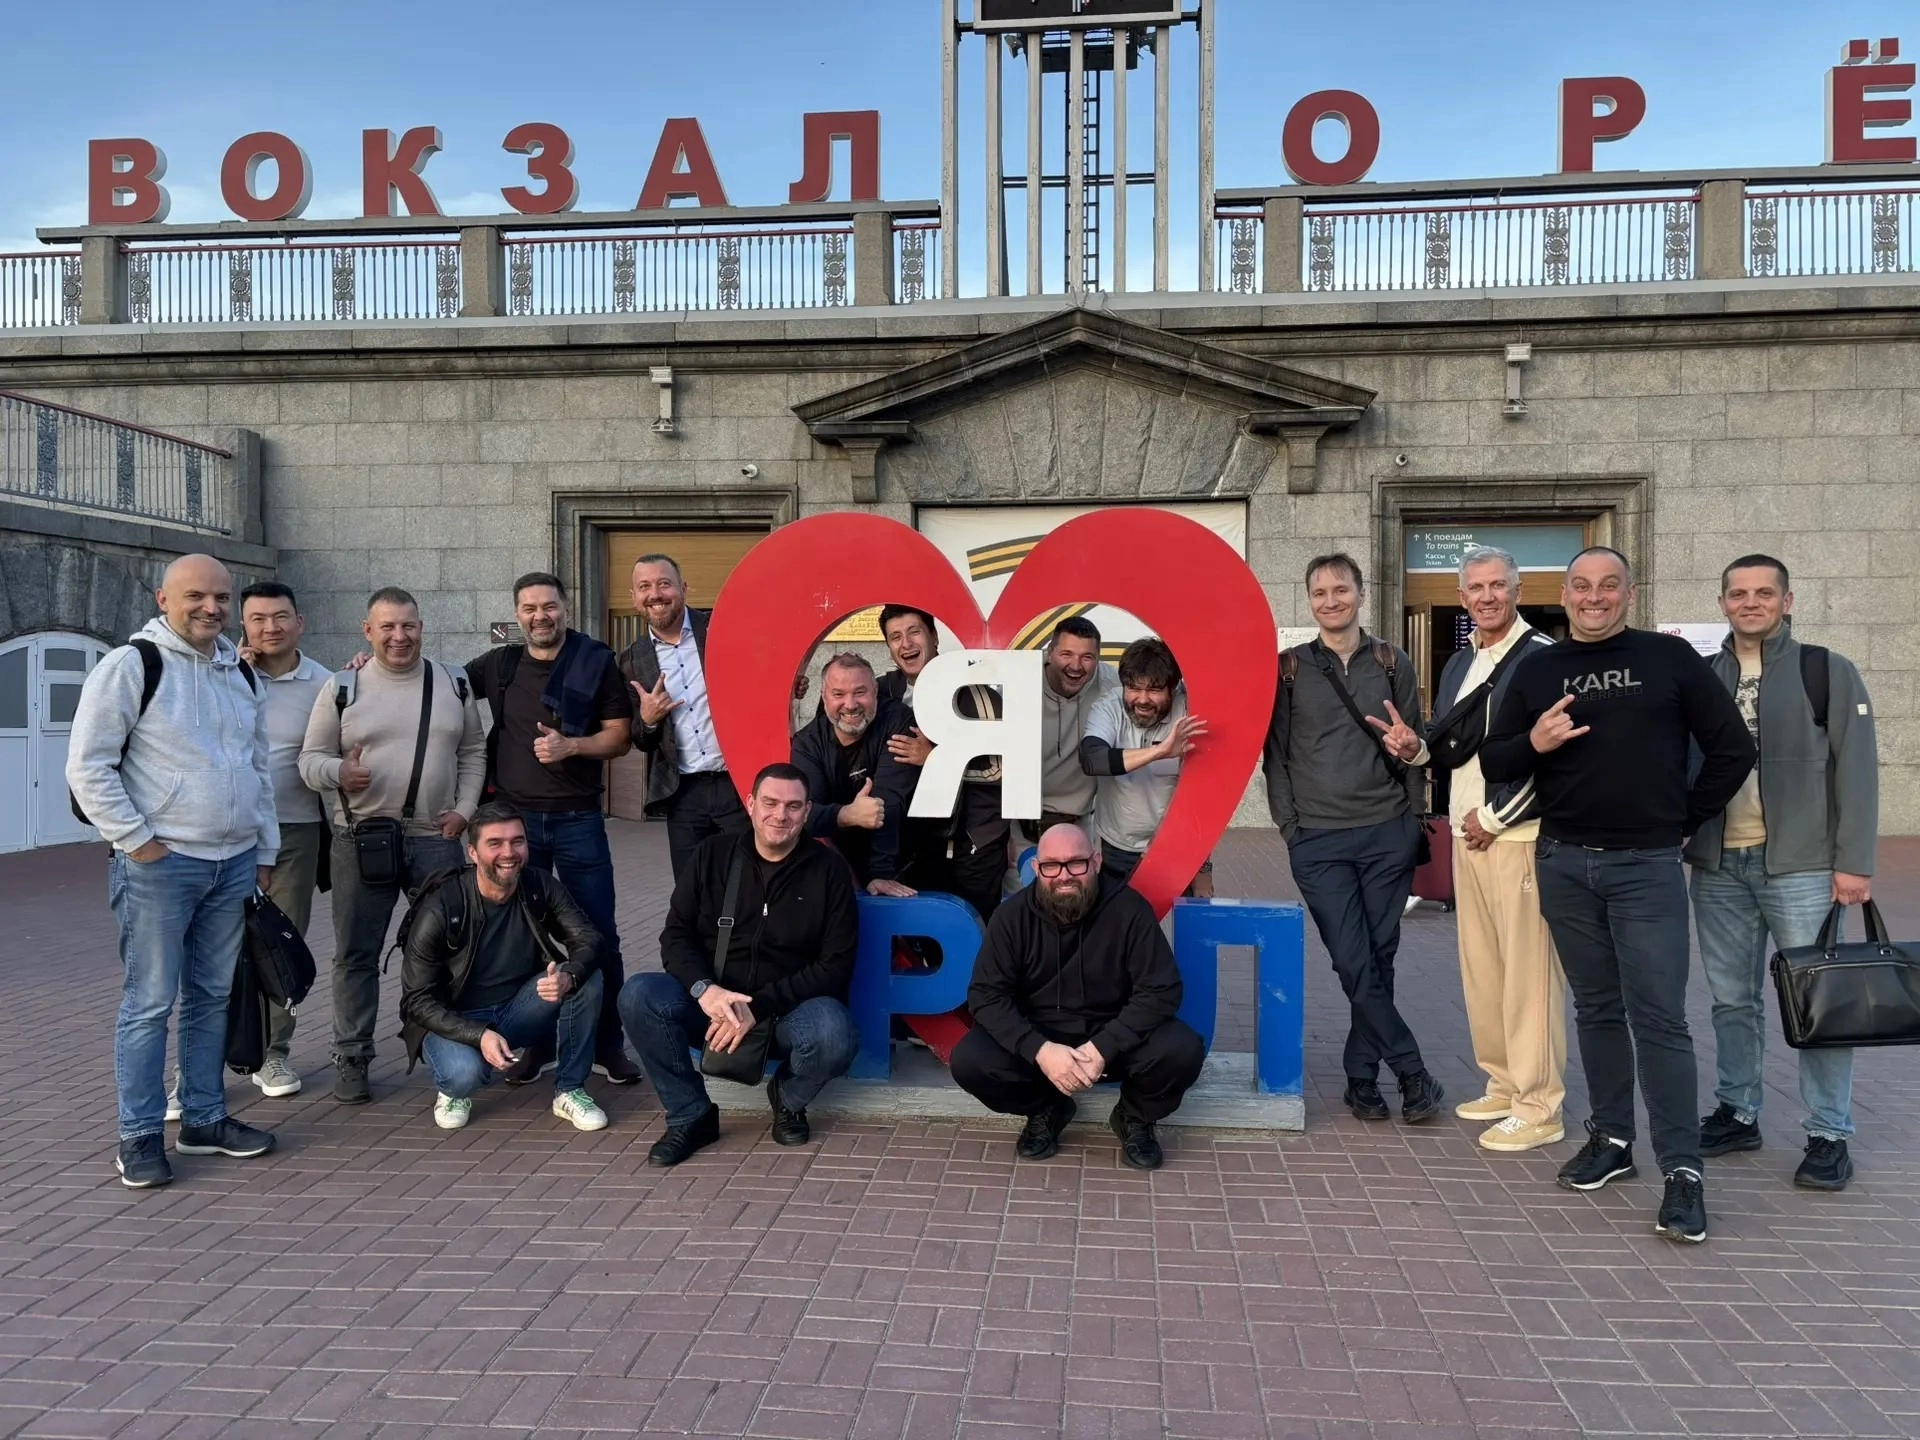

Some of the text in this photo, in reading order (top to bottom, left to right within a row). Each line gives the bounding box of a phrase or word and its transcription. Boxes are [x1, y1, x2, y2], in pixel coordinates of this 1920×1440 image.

[88, 109, 882, 225] ВОКЗАЛ
[1425, 533, 1432, 541] К
[1437, 542, 1460, 550] trains
[1563, 668, 1642, 695] KARL
[1575, 686, 1643, 703] GERFELD
[907, 650, 1043, 820] Я
